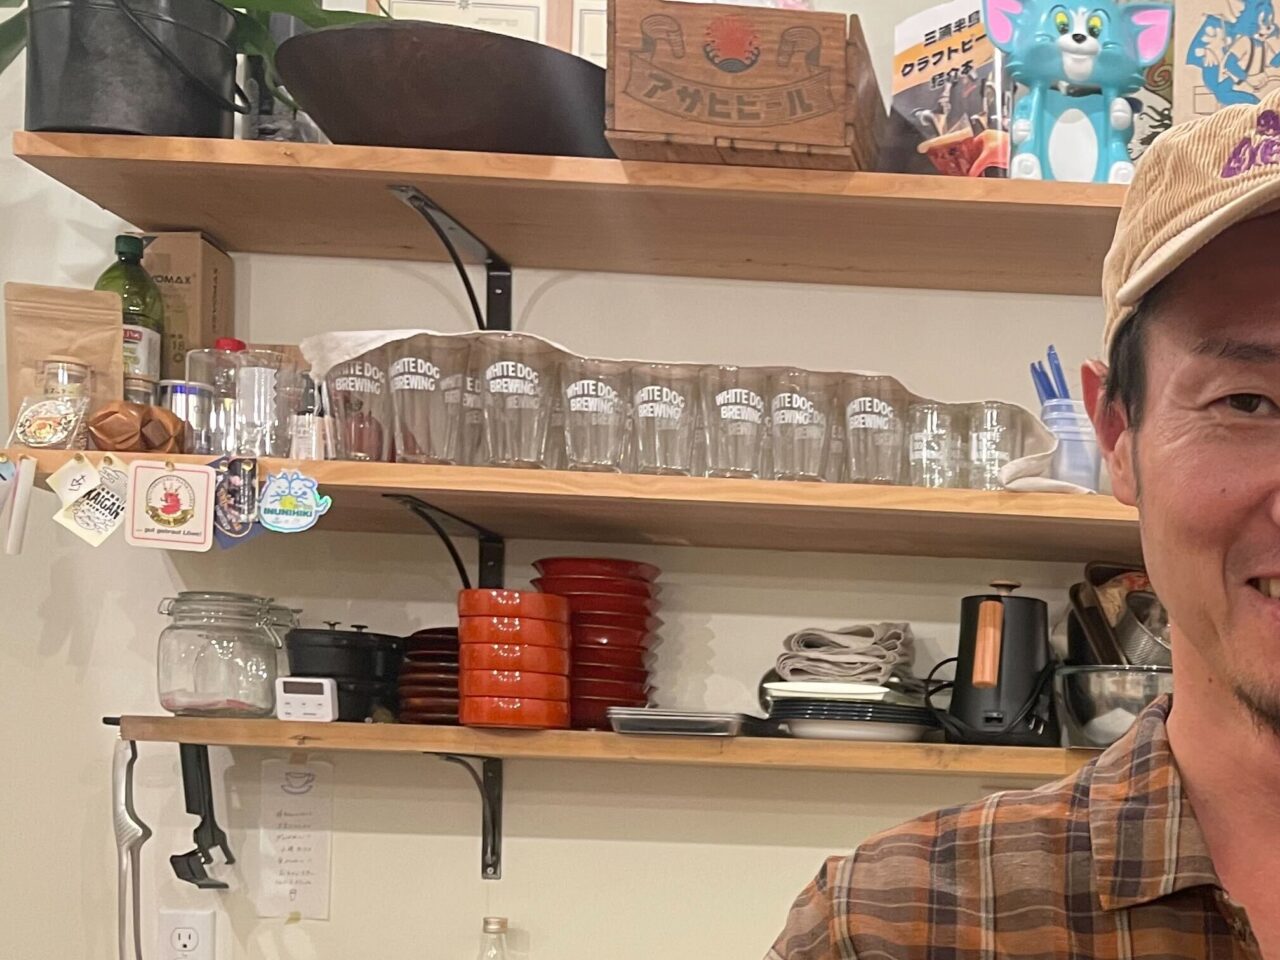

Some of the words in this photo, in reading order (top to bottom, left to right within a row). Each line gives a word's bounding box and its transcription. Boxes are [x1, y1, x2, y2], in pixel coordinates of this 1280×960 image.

[643, 73, 814, 121] アサヒビール
[417, 358, 440, 380] DOG
[486, 361, 516, 381] WHITE
[517, 362, 539, 384] DOG
[335, 377, 381, 395] BREWING
[393, 374, 436, 392] BREWING
[490, 378, 536, 396] BREWING
[570, 397, 614, 415] BREWING
[662, 387, 685, 409] DOG
[715, 388, 749, 407] WHITE
[772, 392, 792, 412] HITE
[792, 393, 814, 413] DOG
[638, 402, 682, 419] BREWING
[873, 398, 894, 418] DOG
